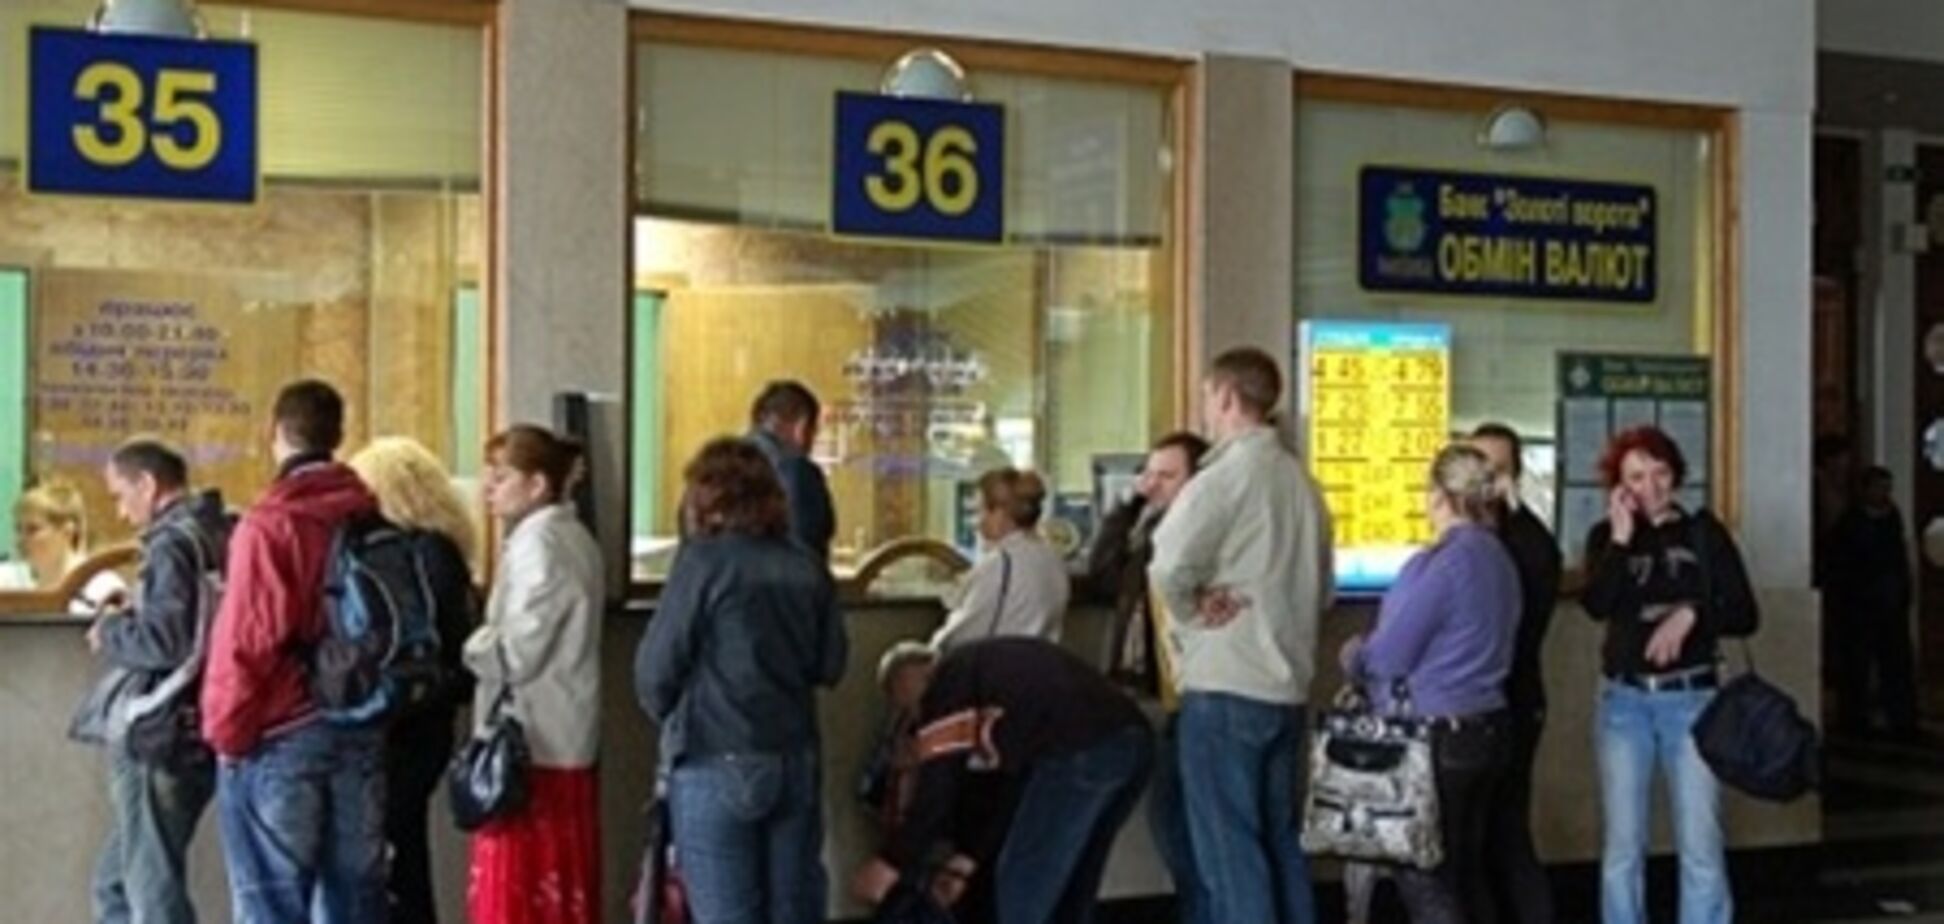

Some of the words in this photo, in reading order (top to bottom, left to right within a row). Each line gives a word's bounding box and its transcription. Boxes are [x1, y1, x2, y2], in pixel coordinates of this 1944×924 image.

[72, 62, 222, 171] 35
[864, 120, 980, 216] 36
[1437, 233, 1537, 285] ОБМІН
[1544, 240, 1652, 290] ВАЛЮТ
